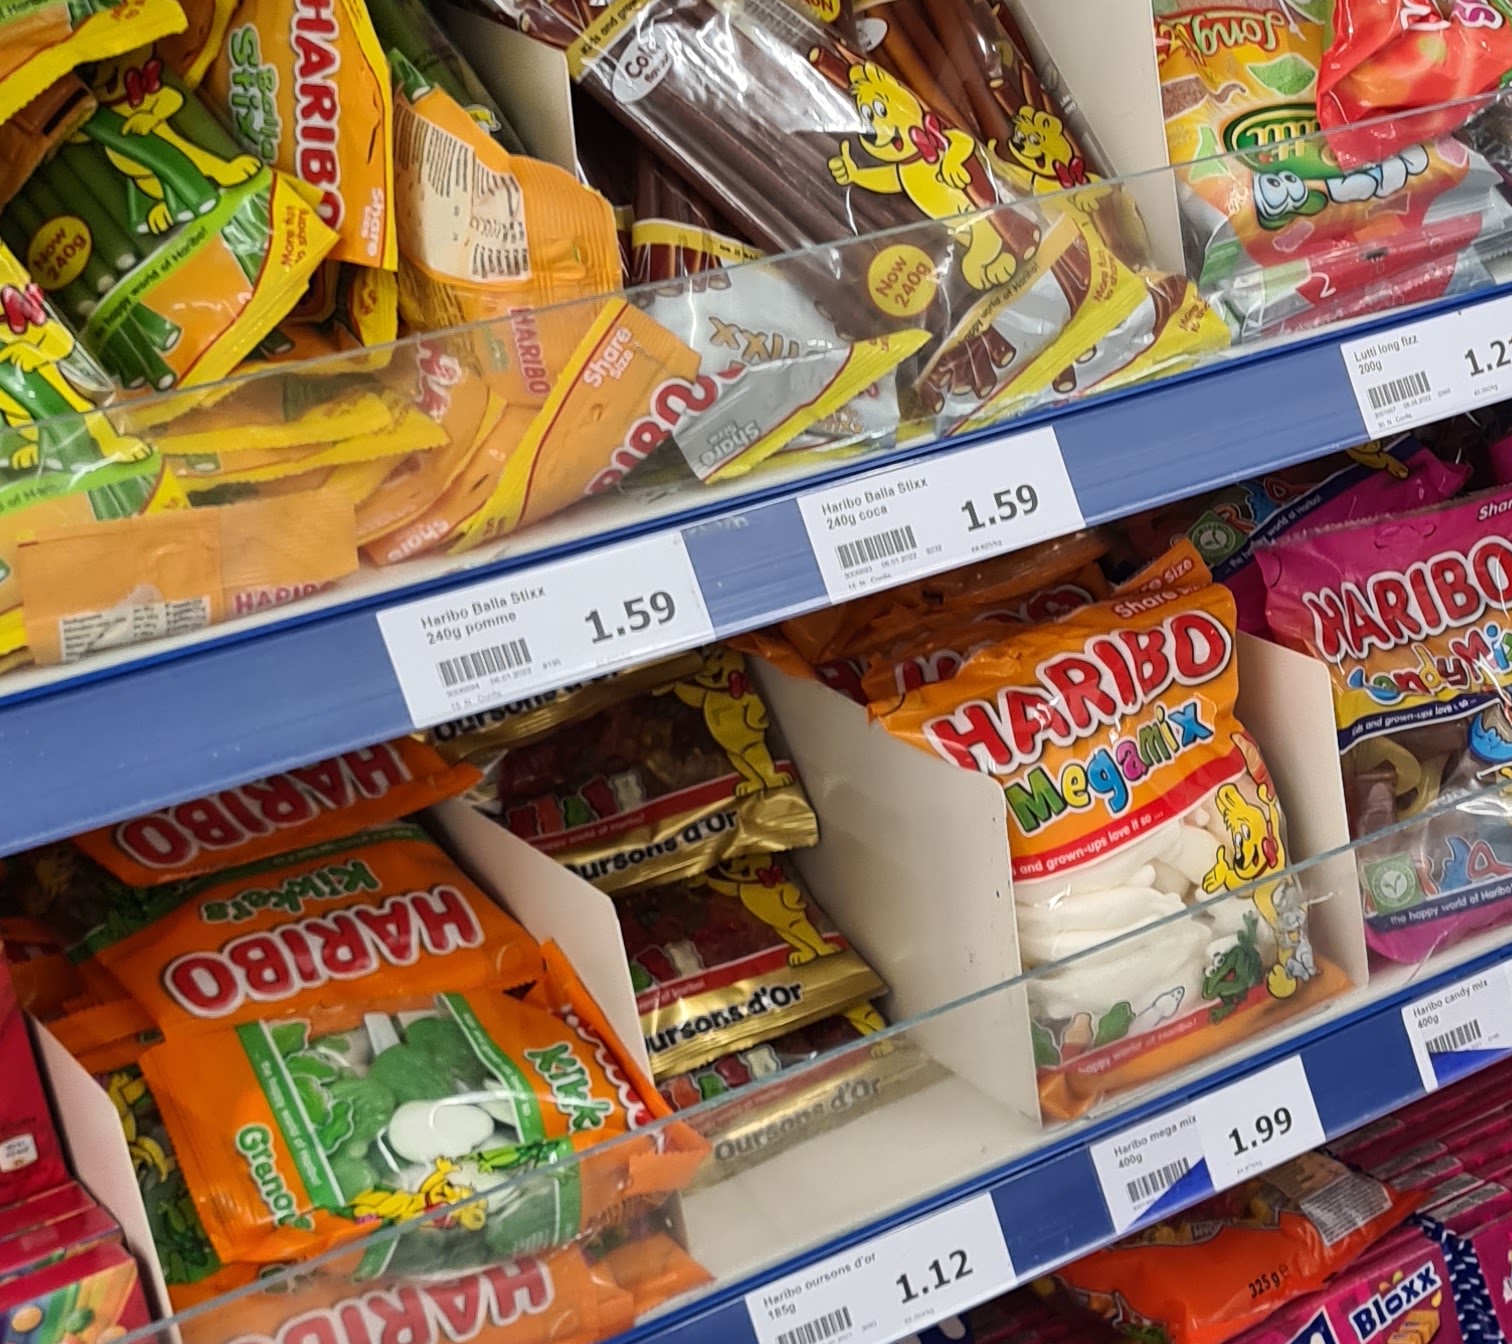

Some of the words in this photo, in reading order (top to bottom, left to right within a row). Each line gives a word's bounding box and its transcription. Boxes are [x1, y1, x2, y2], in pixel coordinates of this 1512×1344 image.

[893, 262, 934, 311] 240g
[582, 325, 635, 390] Share
[1354, 344, 1378, 363] Lutti
[1378, 338, 1400, 358] long
[1400, 333, 1419, 350] fizz
[821, 495, 862, 519] Haribo
[864, 488, 898, 510] Balla
[898, 477, 930, 502] Stixx
[825, 508, 857, 530] 240g
[860, 503, 890, 522] coca
[960, 483, 1041, 532] 1.59
[420, 602, 471, 631] Haribo
[473, 593, 510, 619] Balla
[511, 585, 547, 609] Stixx
[425, 622, 460, 646] 240g
[464, 611, 519, 639] pomme
[583, 589, 679, 646] 1.59
[928, 609, 1236, 776] HARIBO
[1004, 699, 1217, 835] Megamix
[683, 806, 740, 852] d'Or
[1045, 835, 1107, 872] grown-ups
[1108, 824, 1131, 845] love
[162, 884, 487, 1018] HARIBO
[747, 977, 804, 1021] d'Or
[1412, 998, 1443, 1019] Haribo
[1444, 987, 1471, 1008] candy
[712, 1102, 831, 1164] Oursons
[831, 1071, 883, 1119] d'Or
[1228, 1106, 1294, 1157] 1.99
[1114, 1138, 1148, 1159] Haribo
[1150, 1124, 1178, 1146] mega
[1118, 1151, 1143, 1170] 400g
[762, 1283, 803, 1306] Haribo
[805, 1266, 852, 1291] oursons
[896, 1248, 974, 1304] 1.12
[1248, 1274, 1270, 1299] 325
[767, 1300, 797, 1320] 185g
[1352, 1262, 1444, 1344] Bloxx
